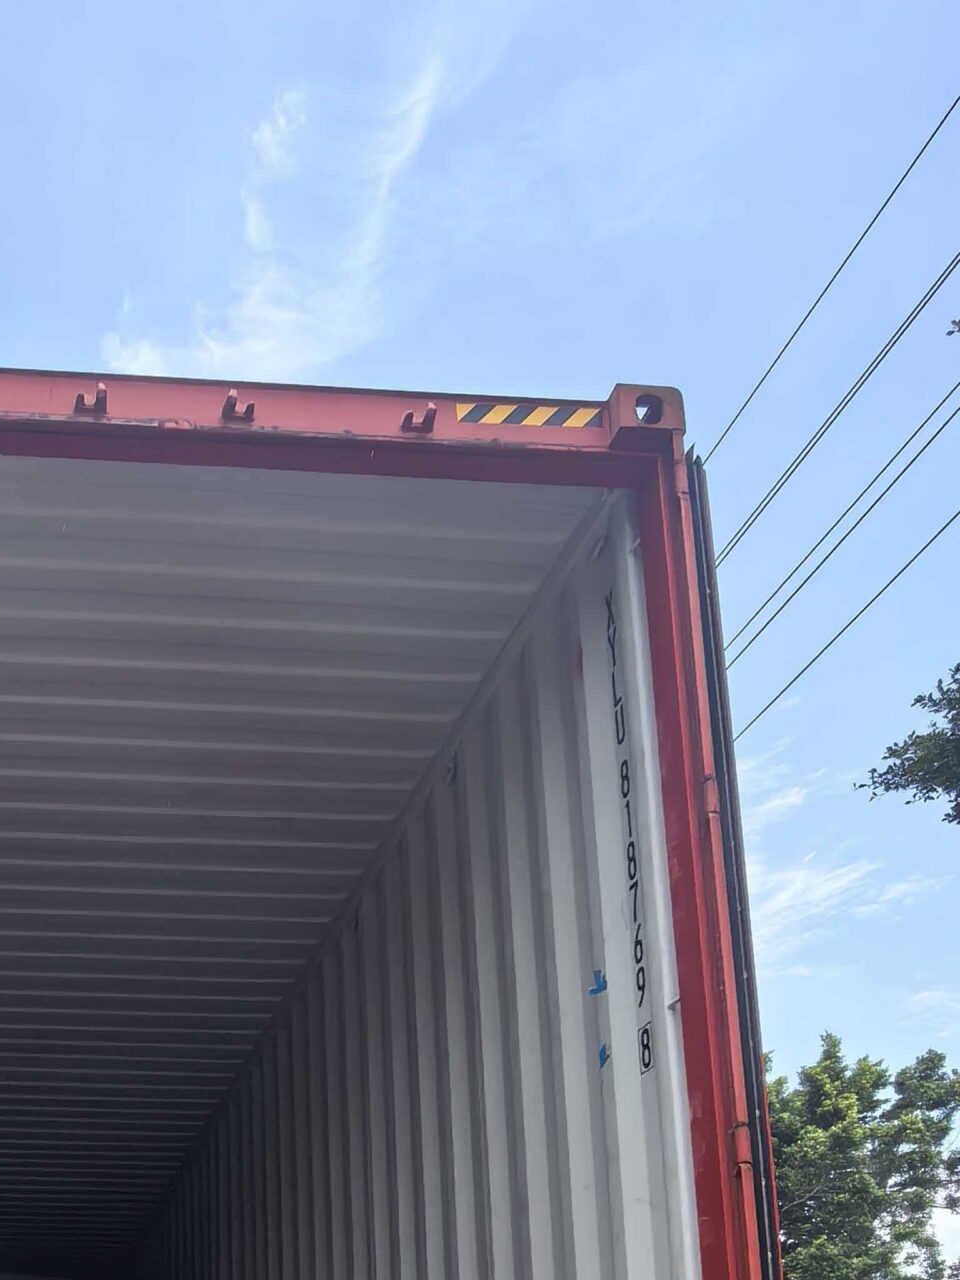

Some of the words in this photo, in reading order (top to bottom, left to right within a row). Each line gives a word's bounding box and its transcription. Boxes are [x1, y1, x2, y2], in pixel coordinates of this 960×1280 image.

[605, 589, 626, 745] XYLU
[620, 759, 646, 1008] 818769
[640, 1027, 652, 1069] 8
